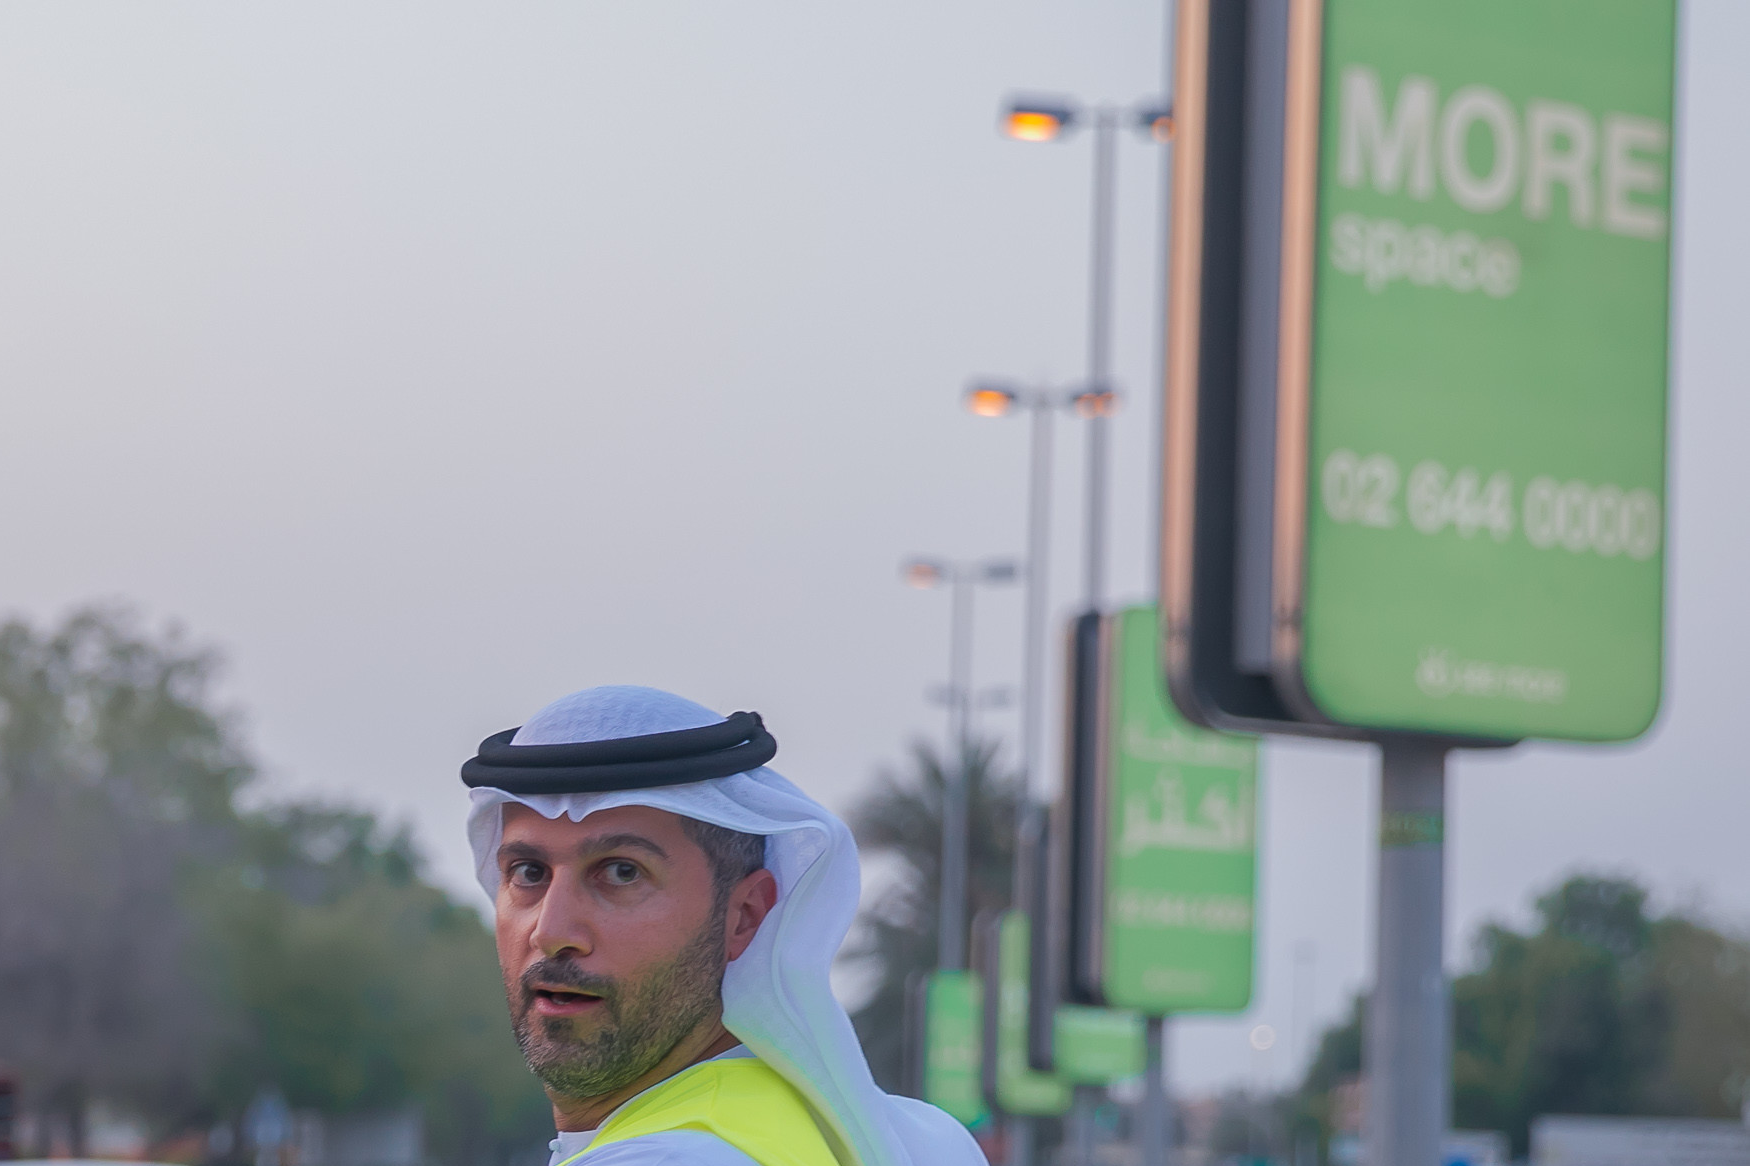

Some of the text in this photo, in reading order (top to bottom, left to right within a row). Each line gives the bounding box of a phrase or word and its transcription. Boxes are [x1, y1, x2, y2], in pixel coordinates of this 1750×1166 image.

[1337, 62, 1669, 241] MORE
[1330, 212, 1521, 298] space
[1322, 448, 1661, 560] 02 644 0000
